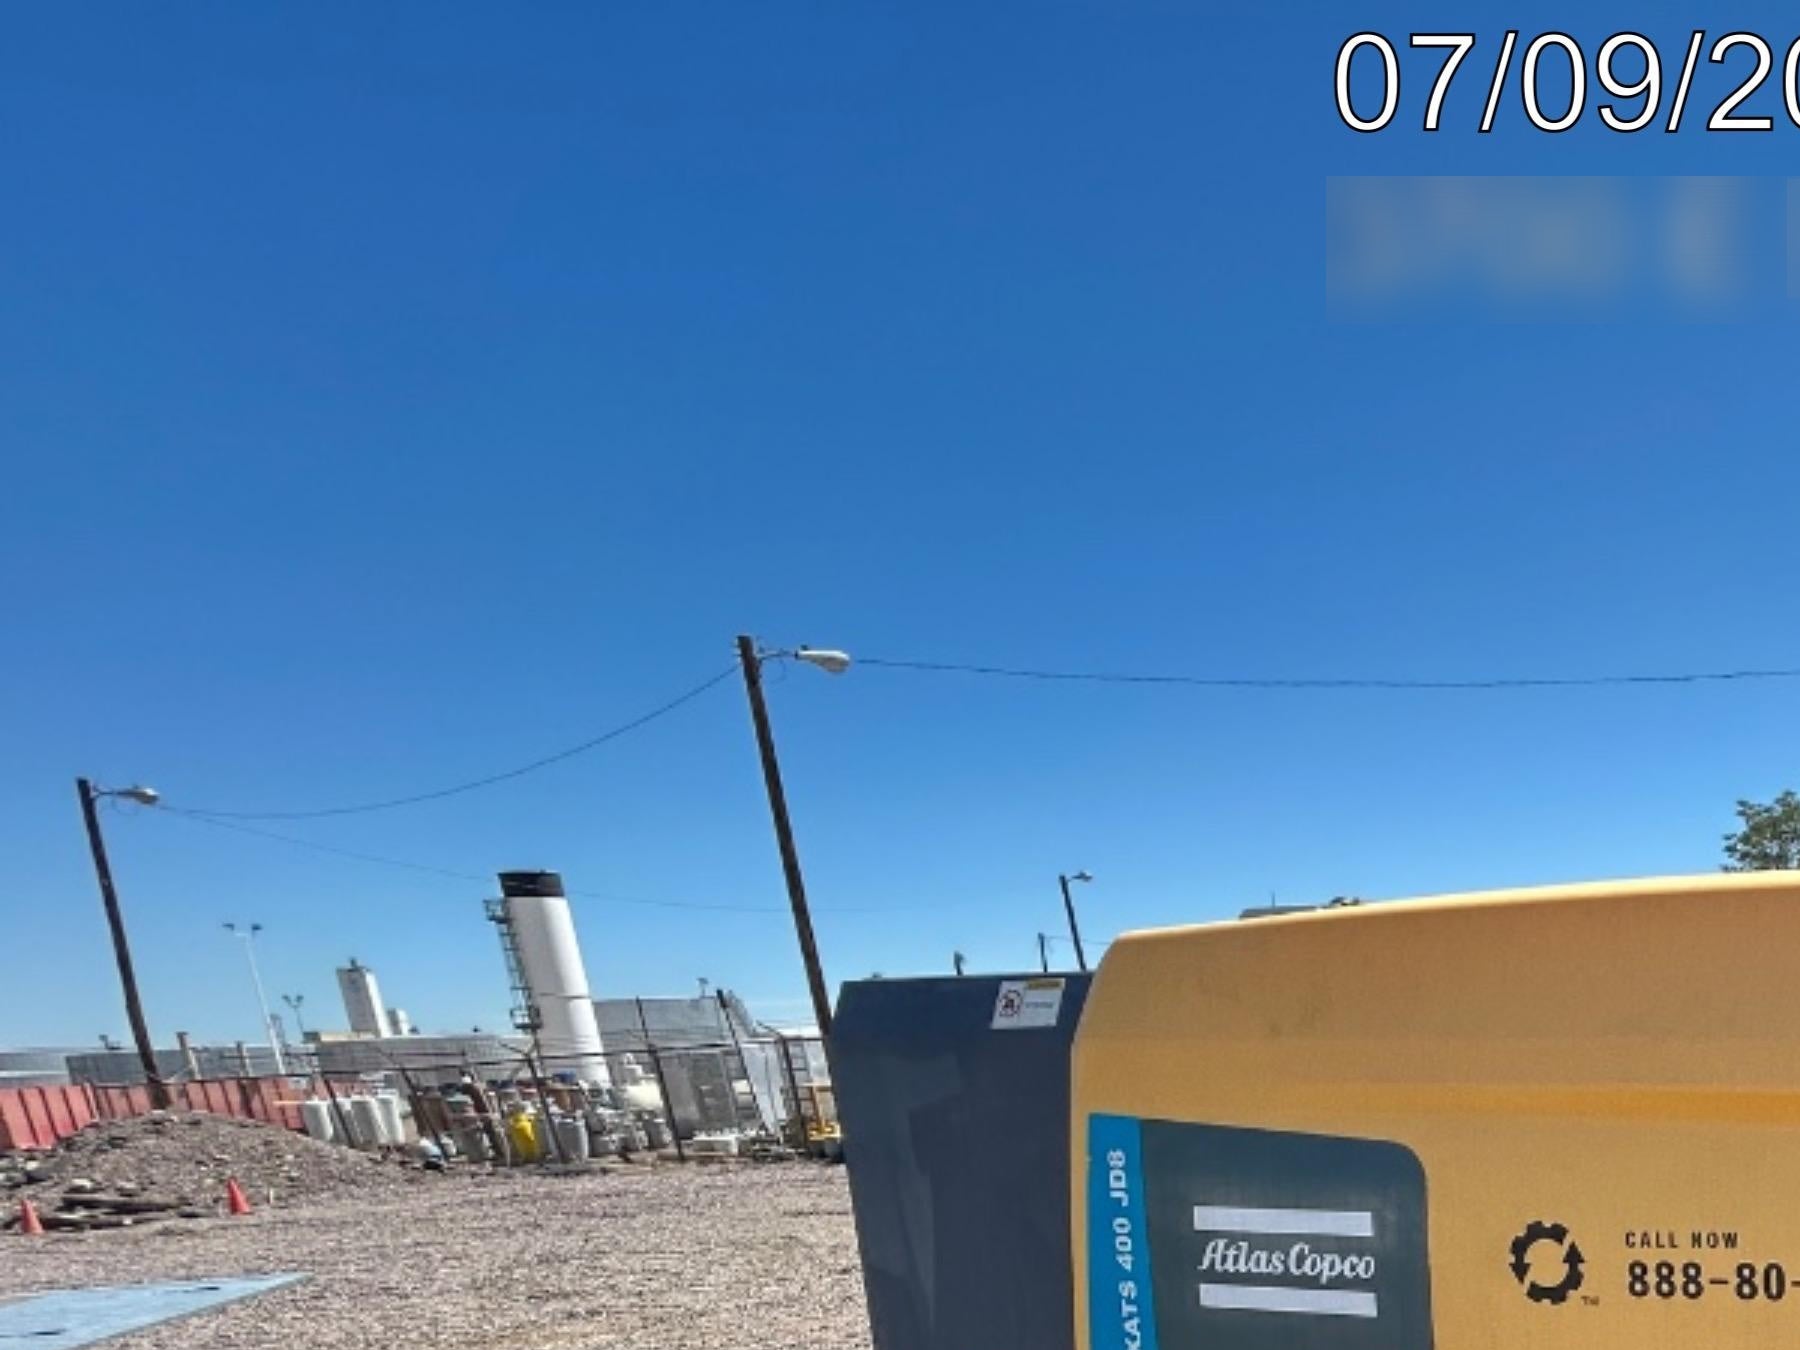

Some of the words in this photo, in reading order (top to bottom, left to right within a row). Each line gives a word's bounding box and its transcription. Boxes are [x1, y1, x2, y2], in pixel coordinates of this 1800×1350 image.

[1107, 1149, 1130, 1207] JD8
[1112, 1217, 1135, 1272] 400
[1197, 1238, 1285, 1275] Atlas
[1287, 1242, 1376, 1285] Copco
[1625, 1231, 1679, 1249] CALL
[1691, 1232, 1738, 1249] NOW
